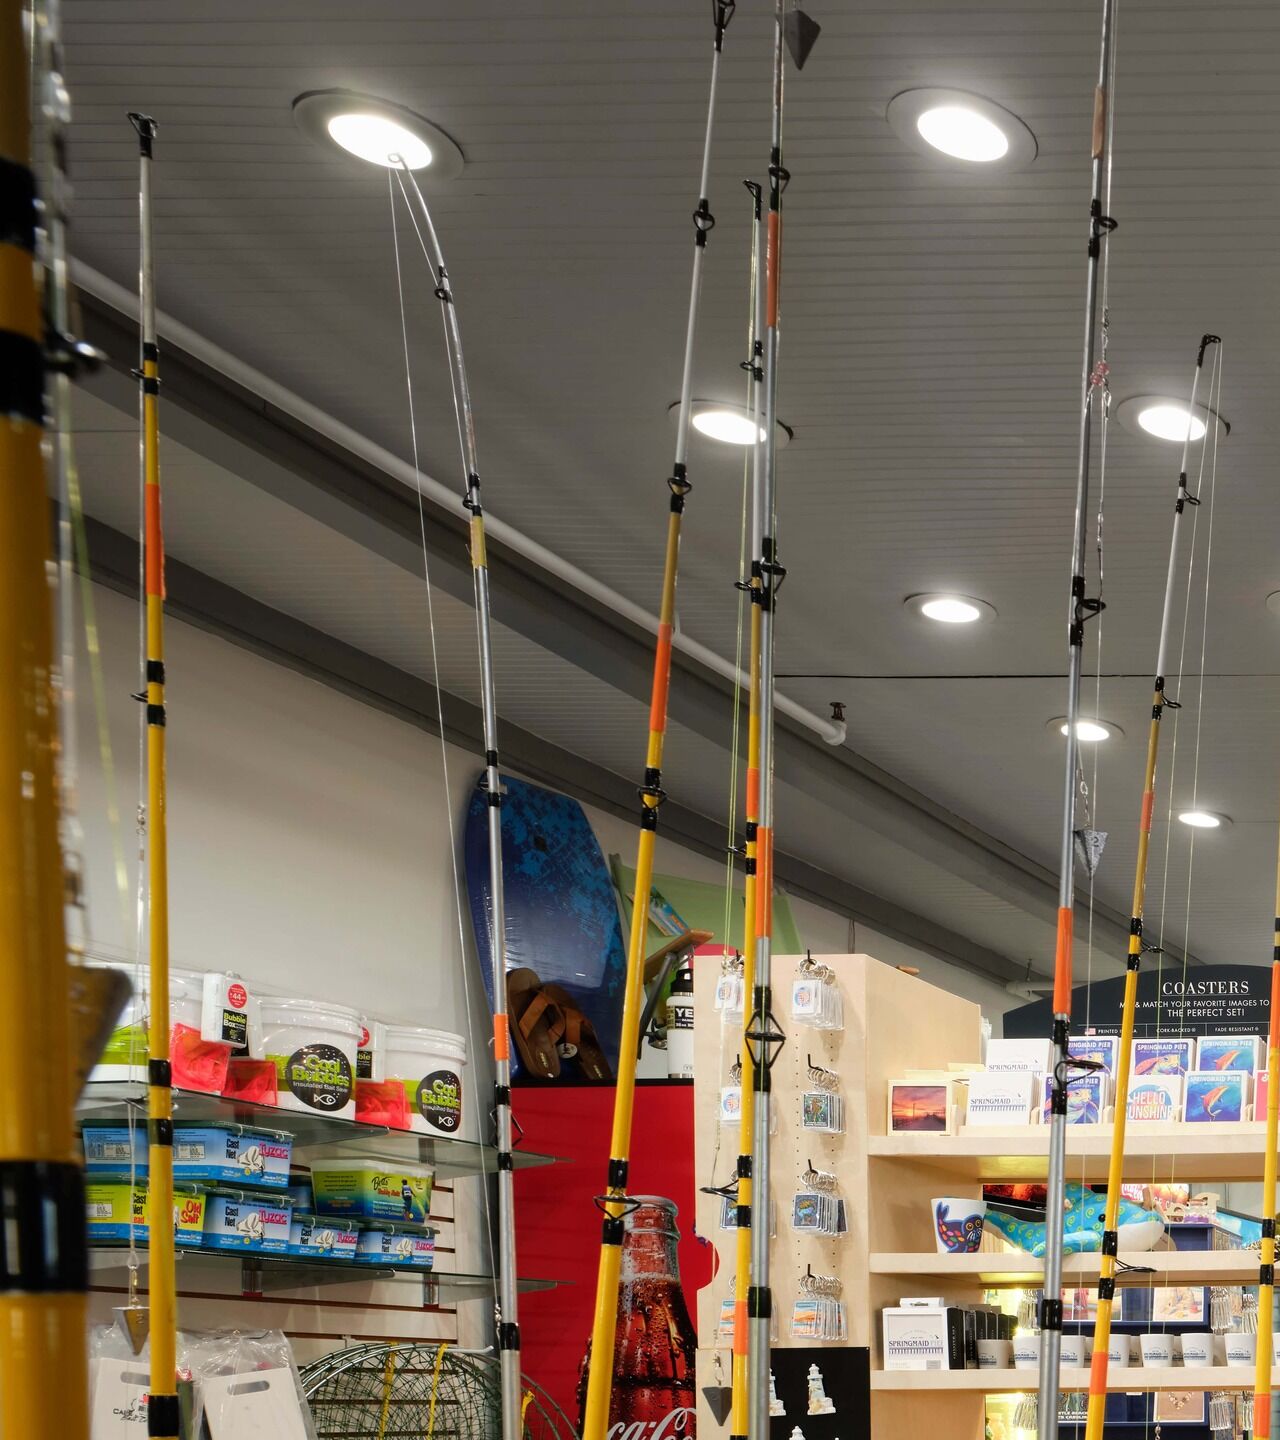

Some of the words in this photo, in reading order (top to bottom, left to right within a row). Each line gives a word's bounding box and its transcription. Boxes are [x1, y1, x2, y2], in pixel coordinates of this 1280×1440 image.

[1162, 981, 1249, 995] COASTERS
[1171, 1000, 1191, 1008] YOUR
[675, 1008, 694, 1017] YE
[1167, 1009, 1183, 1017] THE
[1187, 1008, 1222, 1017] PERFECT
[421, 1089, 460, 1106] Bubble
[1134, 1092, 1166, 1104] HELLO
[1128, 1104, 1173, 1120] UNSHINE
[226, 1138, 239, 1149] Cast
[226, 1149, 236, 1159] Net
[225, 1206, 238, 1216] Cast
[225, 1216, 235, 1227] Net
